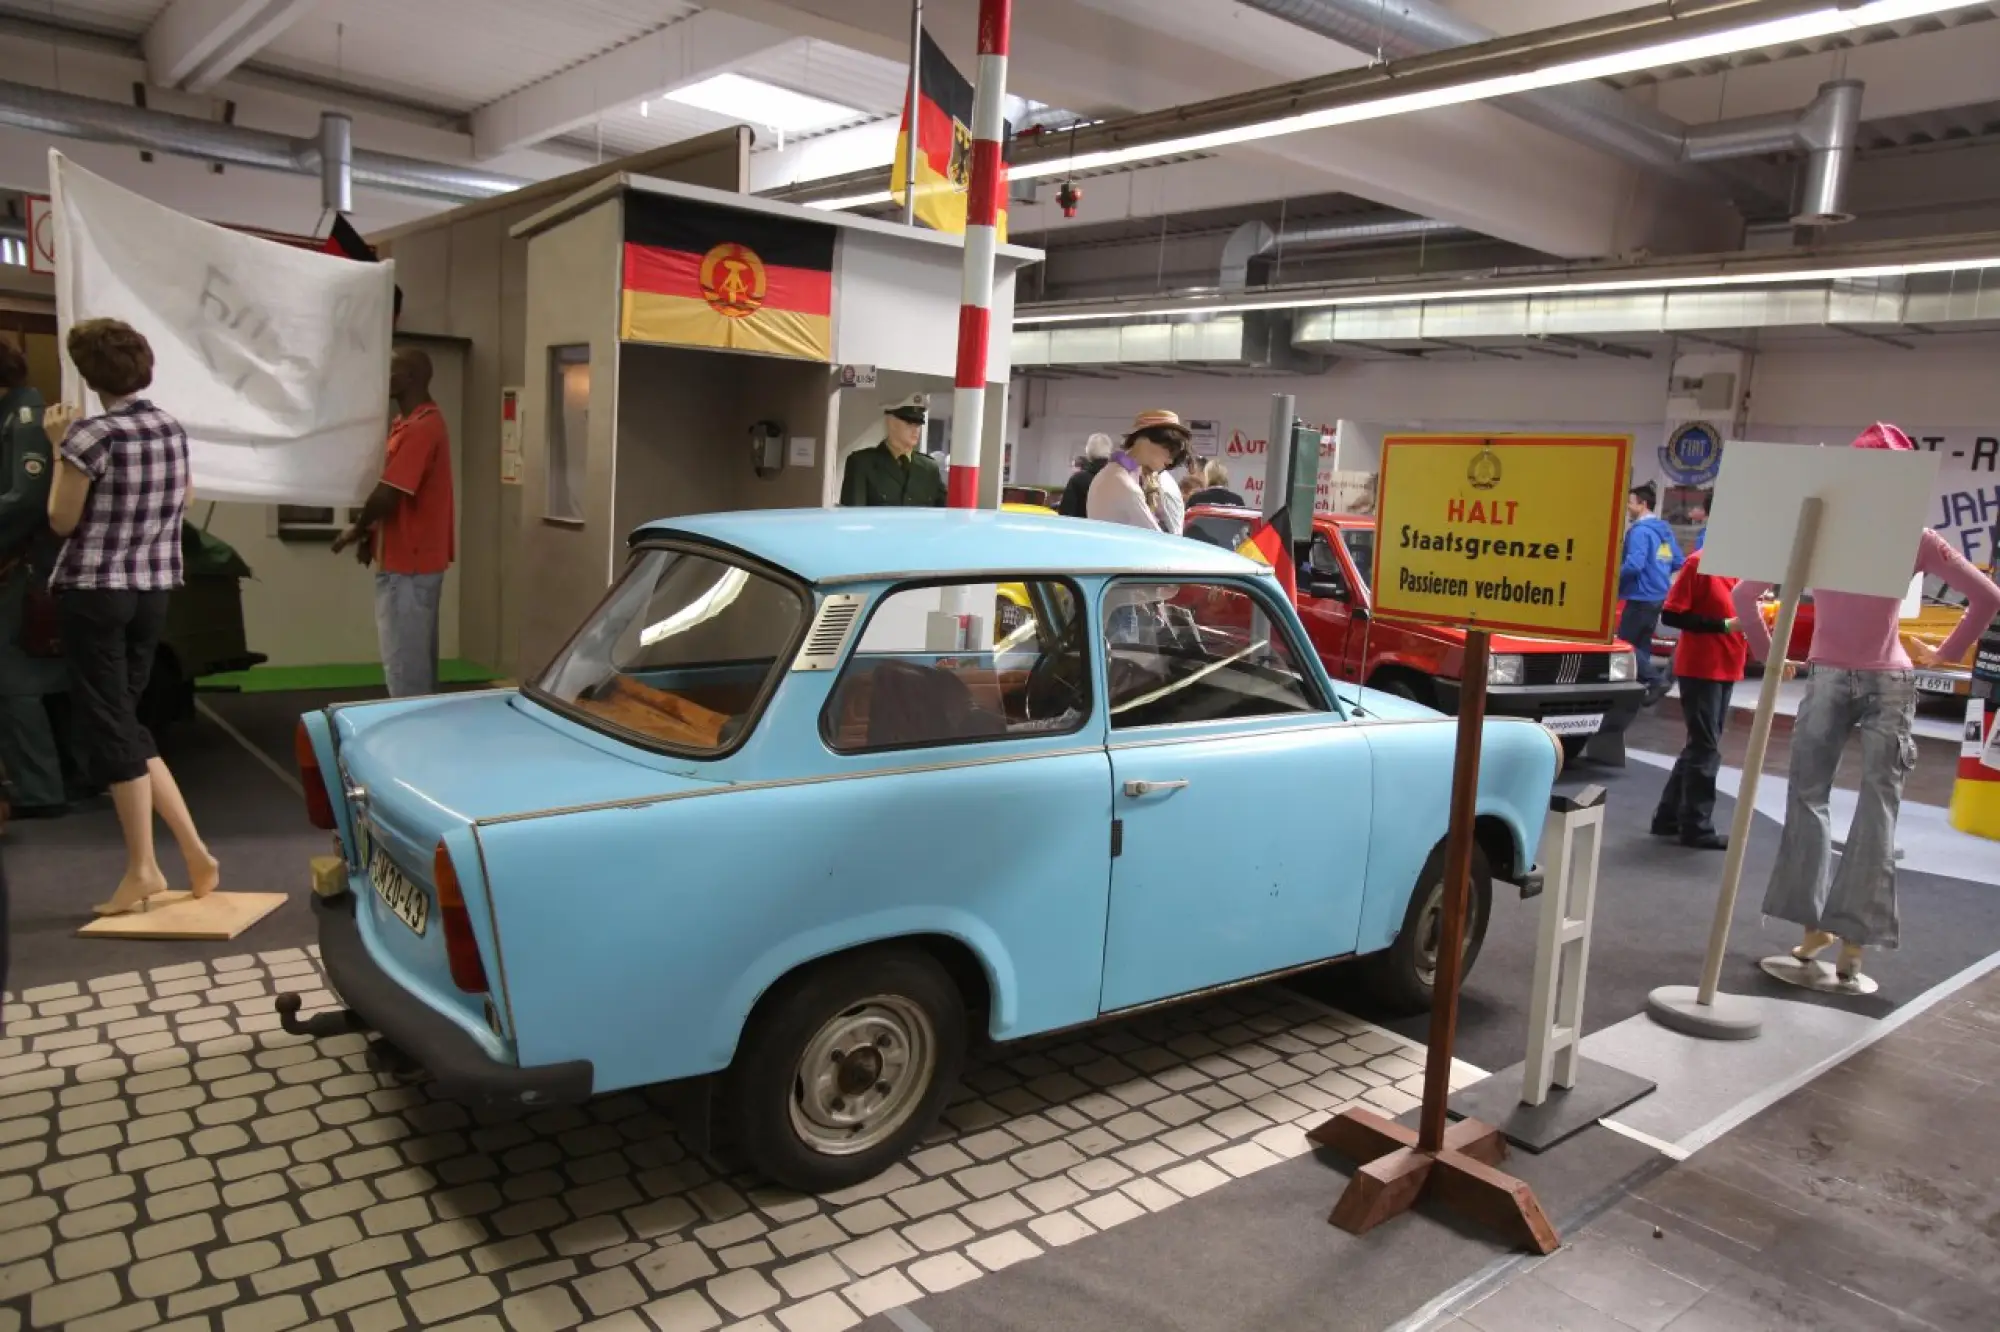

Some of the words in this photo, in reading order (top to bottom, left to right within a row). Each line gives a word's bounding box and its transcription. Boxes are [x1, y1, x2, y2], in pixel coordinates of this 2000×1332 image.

[1681, 439, 1706, 457] FIAT
[1447, 497, 1519, 525] HALT
[1400, 524, 1574, 561] Staatsgrenze!
[1400, 566, 1468, 598] Passieren
[1475, 575, 1567, 607] verboten!
